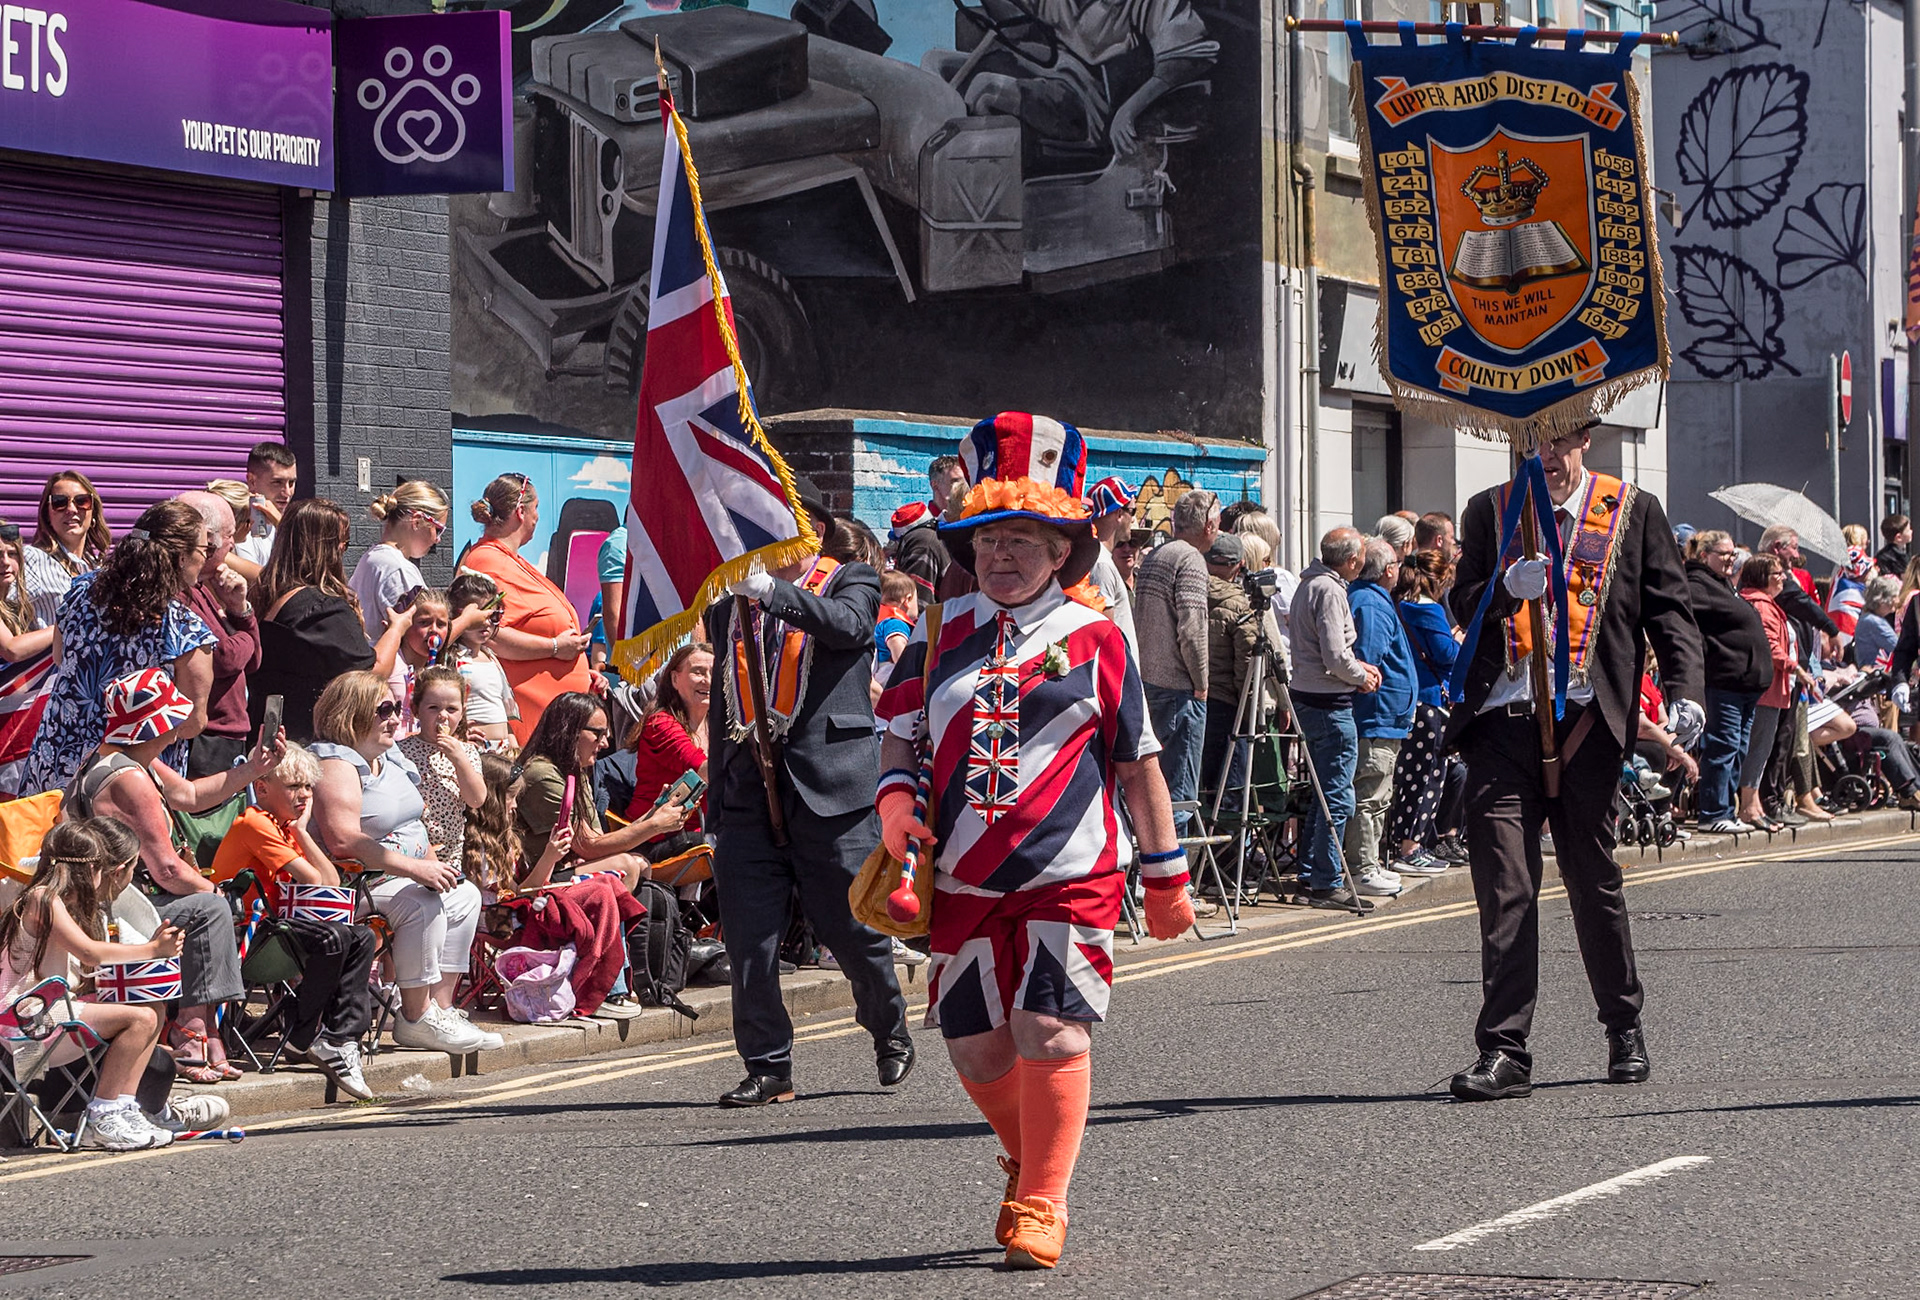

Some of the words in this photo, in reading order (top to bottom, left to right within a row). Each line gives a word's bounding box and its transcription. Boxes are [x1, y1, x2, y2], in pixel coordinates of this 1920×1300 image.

[0, 4, 68, 97] ETS
[1389, 87, 1449, 117] UPPER
[1453, 76, 1498, 106] ARDS
[182, 119, 213, 152] YOUR
[214, 124, 236, 155] PET
[237, 127, 248, 157] IS
[249, 129, 272, 160] OUR
[273, 133, 321, 167] PRIORITY
[1597, 153, 1632, 173] 1058
[1389, 176, 1423, 190] 241
[1600, 177, 1633, 195] 1412
[1391, 200, 1429, 214] 552
[1601, 201, 1637, 217] 1592
[1395, 225, 1430, 239] 673
[1602, 223, 1638, 240] 1758
[1398, 248, 1431, 263] 781
[1603, 248, 1642, 265] 1884
[1403, 273, 1439, 288] 836
[1603, 270, 1640, 289] 1900
[1413, 296, 1447, 314] 878
[1472, 296, 1499, 312] THIS
[1502, 297, 1520, 311] WE
[1524, 288, 1556, 305] WILL
[1598, 291, 1637, 313] 1907
[1484, 304, 1548, 326] MAINTAIN
[1584, 311, 1620, 335] 1951
[1423, 316, 1457, 342] 1051
[1448, 356, 1523, 390] COUNTY
[1529, 348, 1591, 386] DOWN
